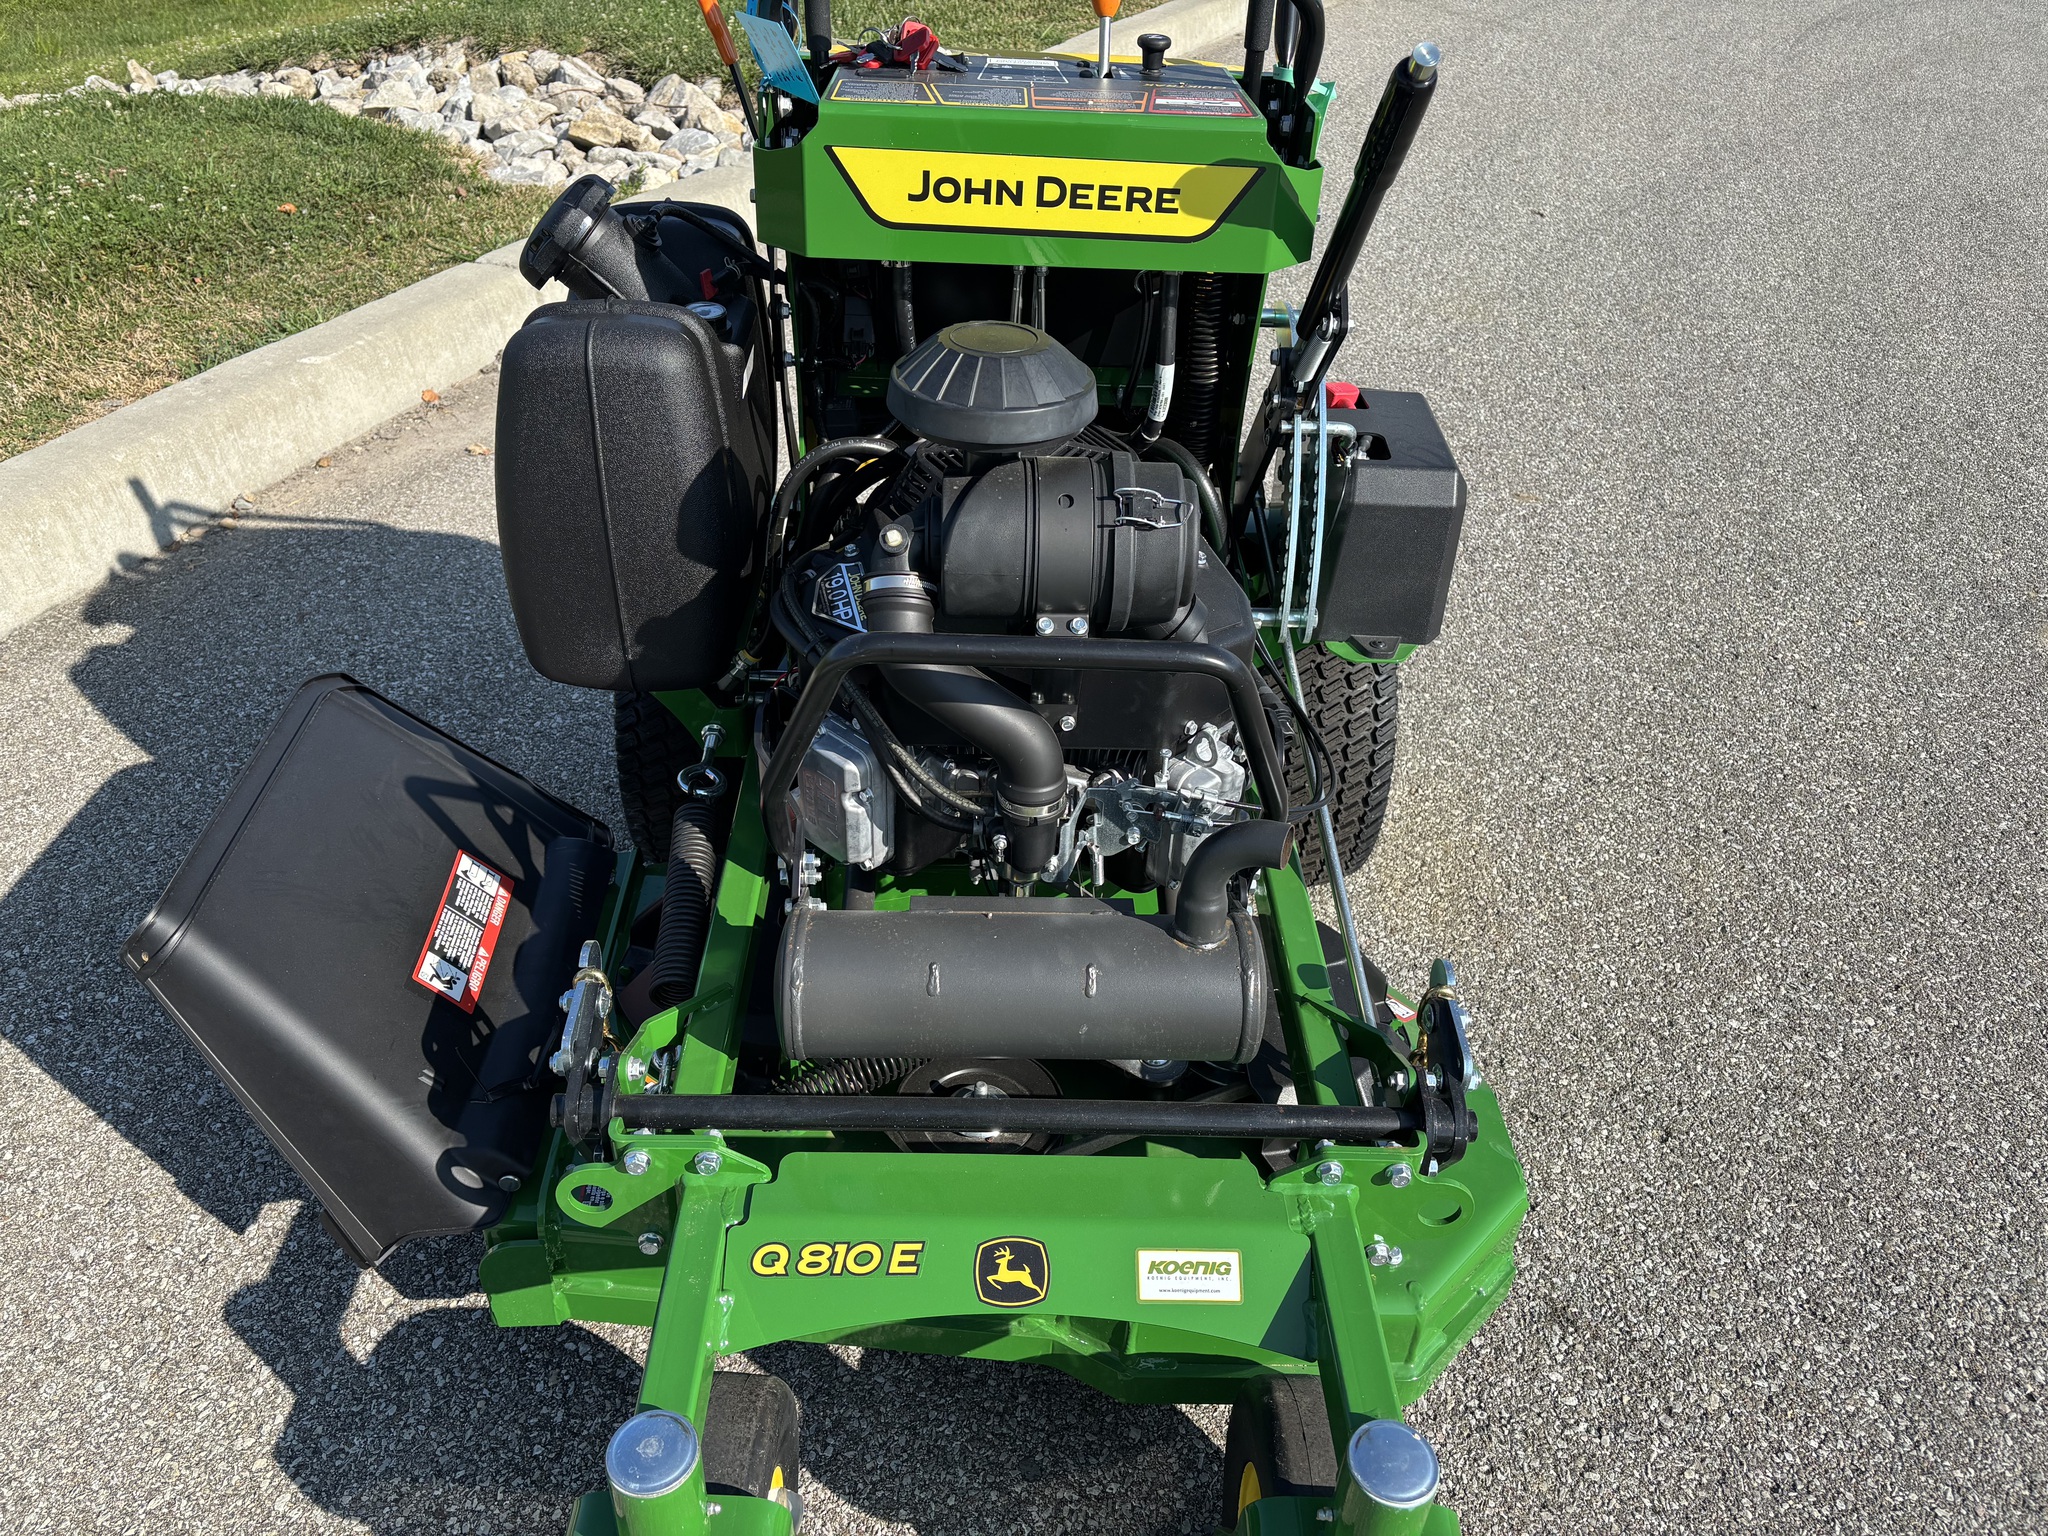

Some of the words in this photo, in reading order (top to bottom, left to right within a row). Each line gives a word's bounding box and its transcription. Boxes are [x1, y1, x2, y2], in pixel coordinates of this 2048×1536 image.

[907, 169, 1024, 207] JOHN
[1035, 176, 1182, 215] DEERE
[847, 571, 863, 593] JOHN
[489, 895, 507, 927] DANGER
[468, 956, 486, 993] PELIGRO
[750, 1241, 791, 1278] Q
[795, 1240, 885, 1278] 810
[885, 1240, 927, 1277] E
